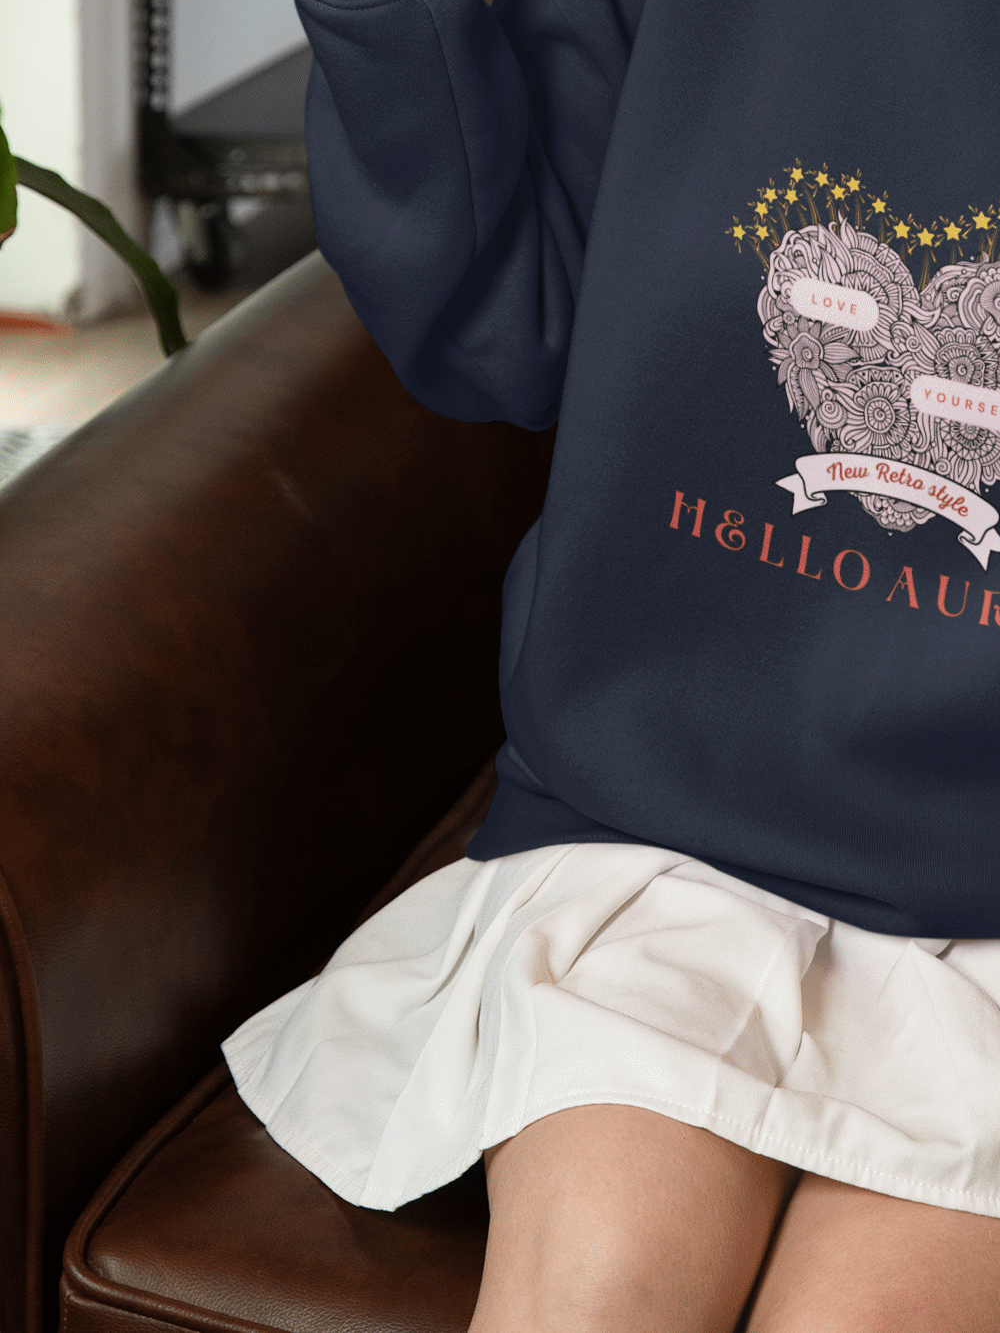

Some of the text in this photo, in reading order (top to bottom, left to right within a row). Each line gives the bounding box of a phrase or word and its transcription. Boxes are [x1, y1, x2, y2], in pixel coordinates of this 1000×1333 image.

[810, 293, 858, 315] LOVE
[827, 462, 968, 517] New Retro style
[669, 490, 871, 591] HELLO
